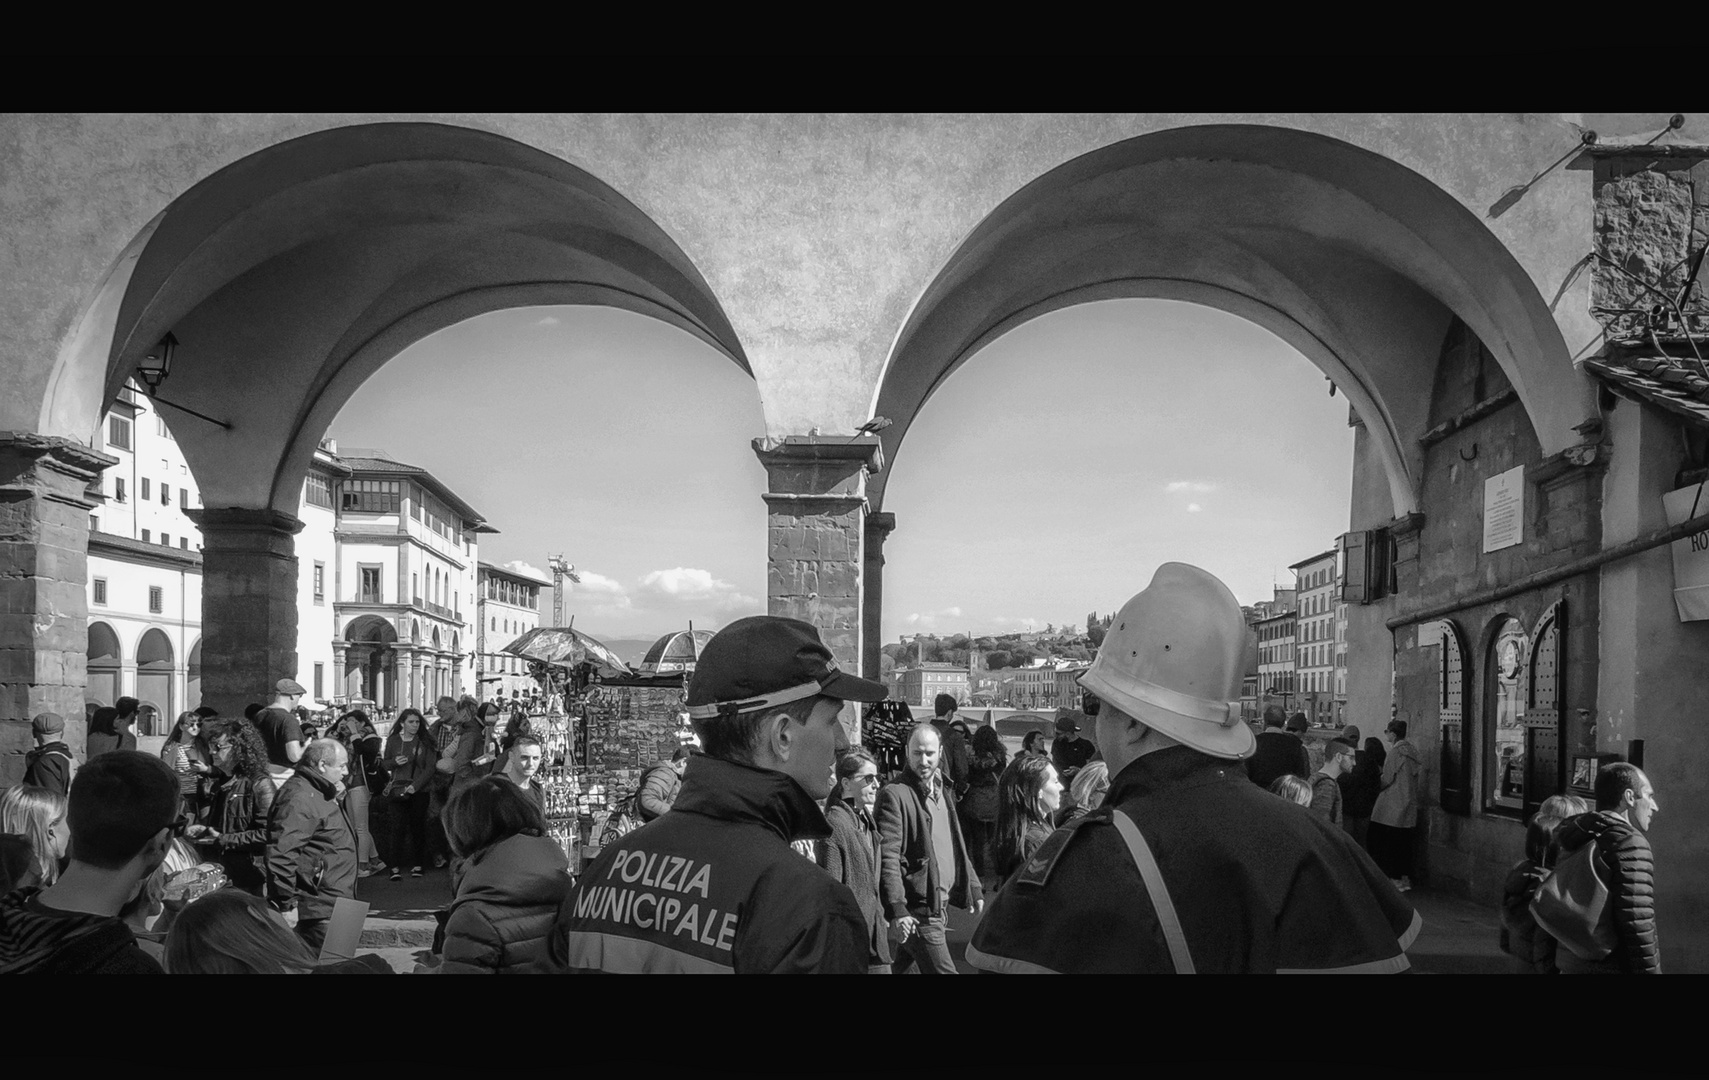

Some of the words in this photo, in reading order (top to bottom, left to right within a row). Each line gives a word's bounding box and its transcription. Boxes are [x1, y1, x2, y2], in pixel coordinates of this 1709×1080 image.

[1691, 530, 1709, 553] RO
[607, 849, 711, 899] POLIZIA
[572, 884, 739, 952] MUNICIPALE
